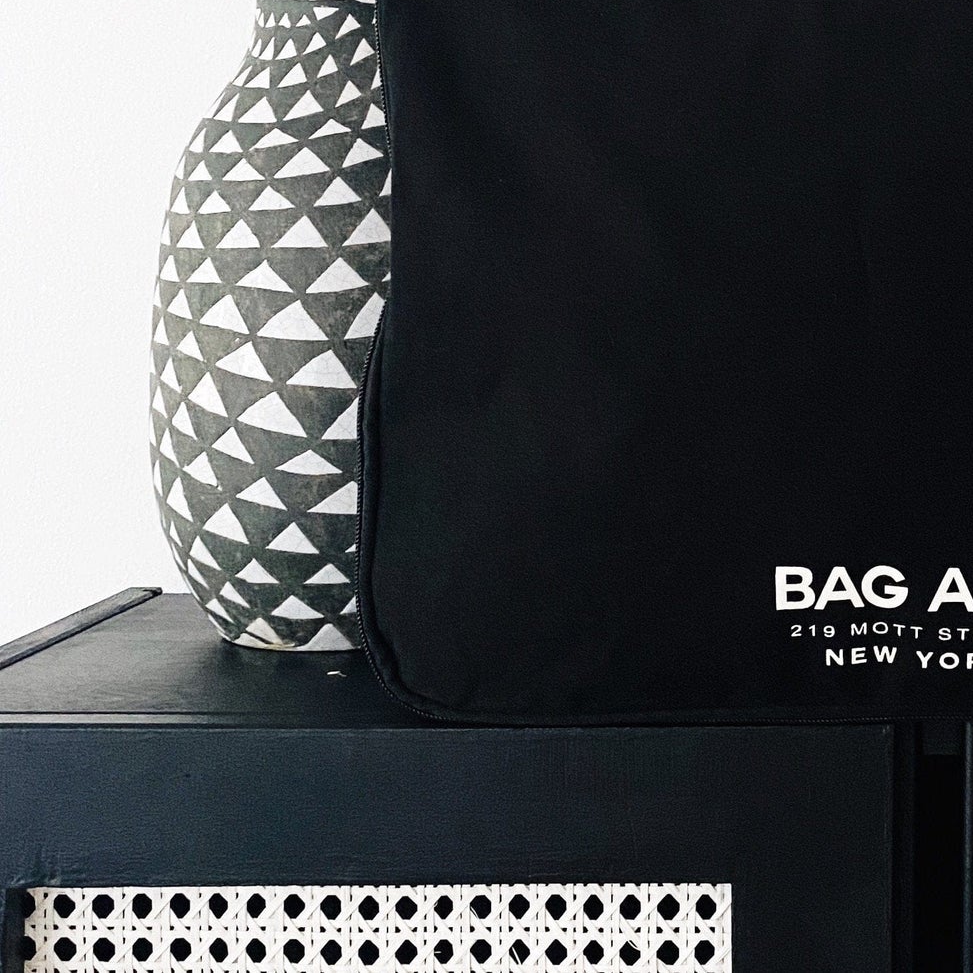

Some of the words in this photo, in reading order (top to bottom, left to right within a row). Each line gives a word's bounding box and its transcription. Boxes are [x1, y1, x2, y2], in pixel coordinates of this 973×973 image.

[775, 565, 908, 610] BAG
[791, 624, 835, 638] 219
[851, 622, 923, 639] MOTT
[825, 646, 897, 666] NEW
